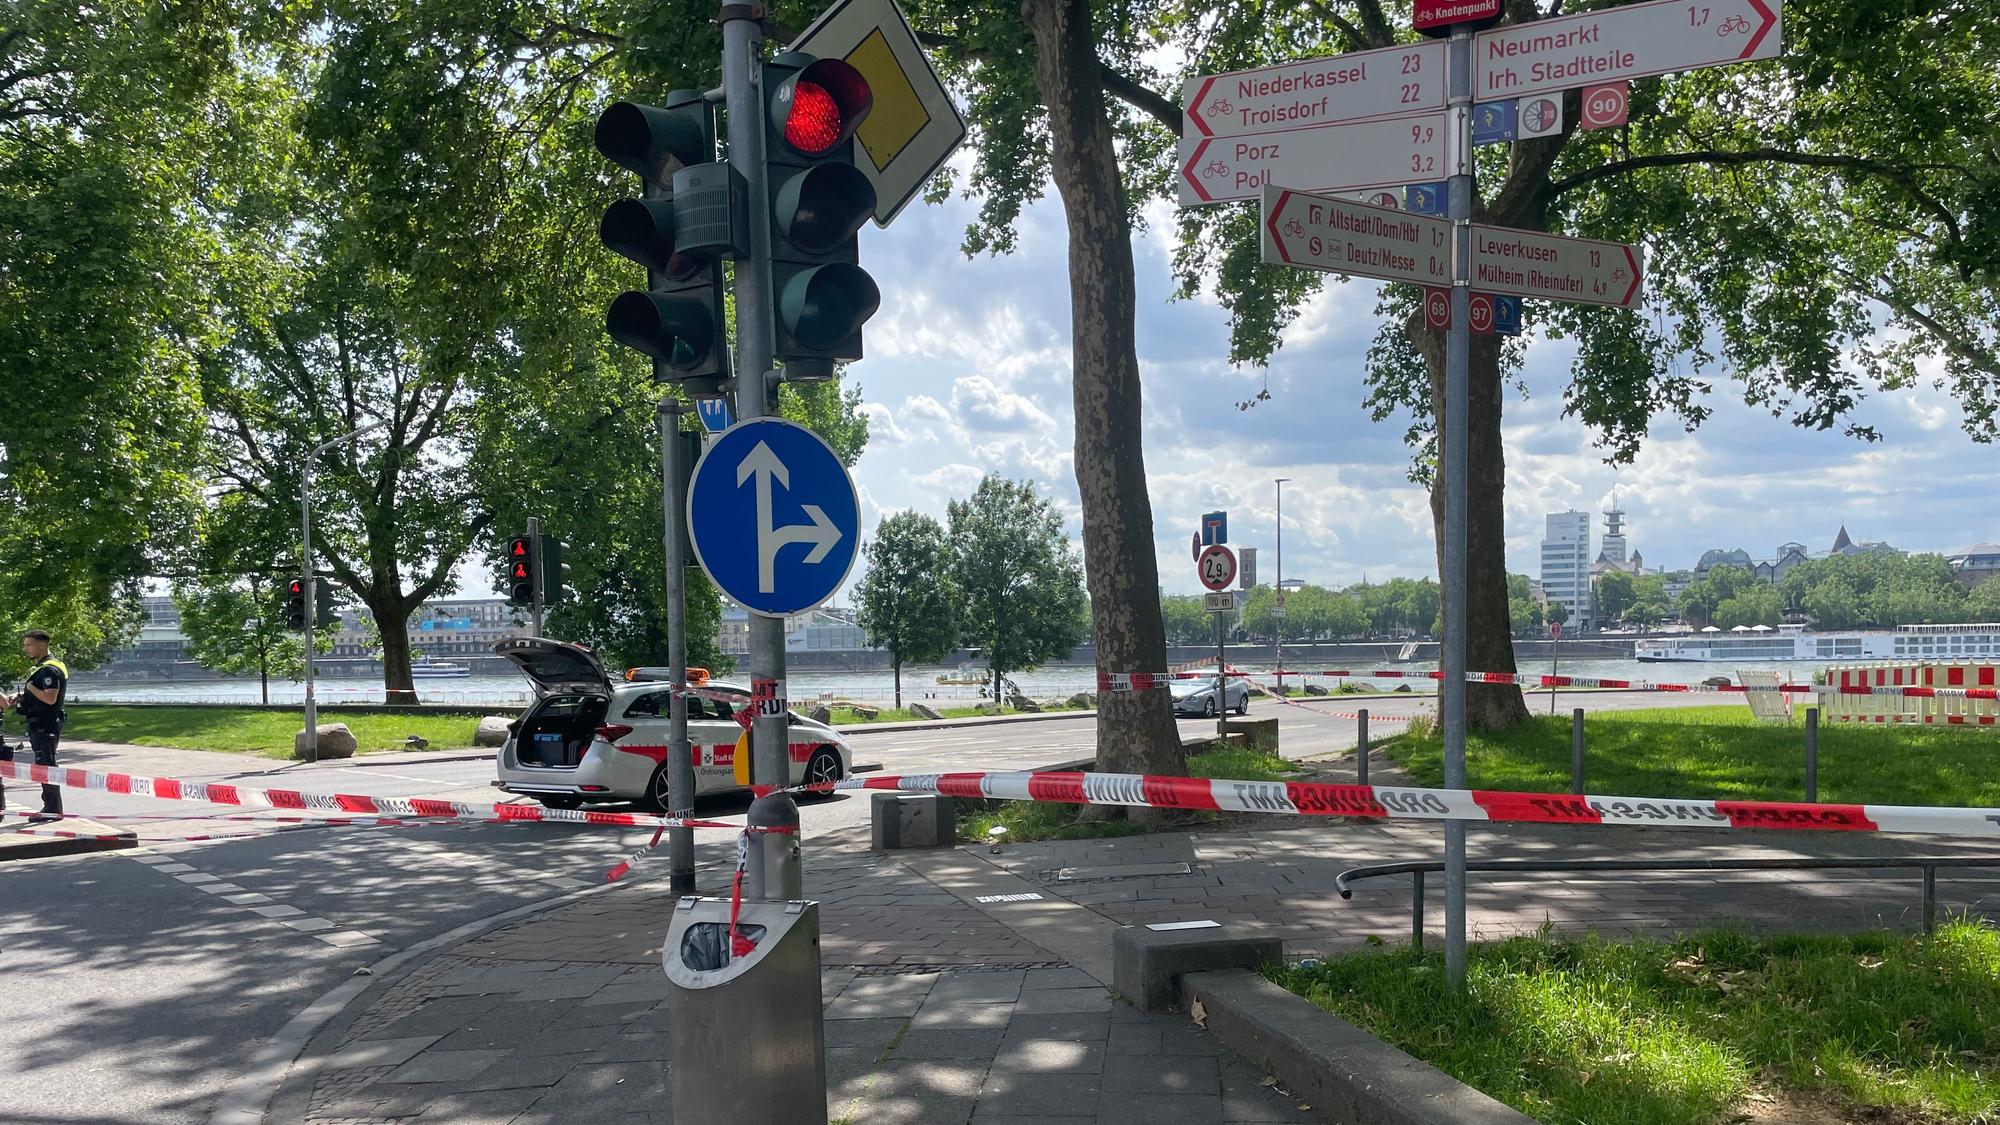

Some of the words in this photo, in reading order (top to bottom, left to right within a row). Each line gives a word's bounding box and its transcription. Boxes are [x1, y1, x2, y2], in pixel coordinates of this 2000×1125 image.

[1435, 0, 1495, 19] Knotenpunkt
[1489, 24, 1599, 60] Neumarkt
[1688, 7, 1710, 29] 1,7
[1238, 63, 1367, 99] Niederkassel
[1401, 54, 1421, 75] 23
[1489, 69, 1523, 90] Irh.
[1532, 51, 1635, 82] Stadtteile
[1239, 97, 1328, 127] Troisdorf
[1401, 83, 1420, 103] 22
[1593, 98, 1617, 114] 90
[1235, 144, 1279, 162] Porz
[1412, 125, 1433, 144] 9,9
[1235, 169, 1271, 190] Poll
[1411, 154, 1433, 173] 3,2
[1329, 208, 1420, 243] Altstadt/Dom/Hbf
[1432, 227, 1444, 247] 1,7
[1347, 243, 1415, 272] Deutz/Messe
[1430, 256, 1444, 277] 0,6
[1479, 235, 1557, 263] Leverkusen
[1590, 250, 1600, 268] 13
[1478, 264, 1524, 287] Mülheim
[1527, 270, 1584, 295] (Rheinufer)
[1593, 278, 1607, 297] 4,9
[1431, 302, 1446, 317] 68
[1472, 307, 1487, 321] 97
